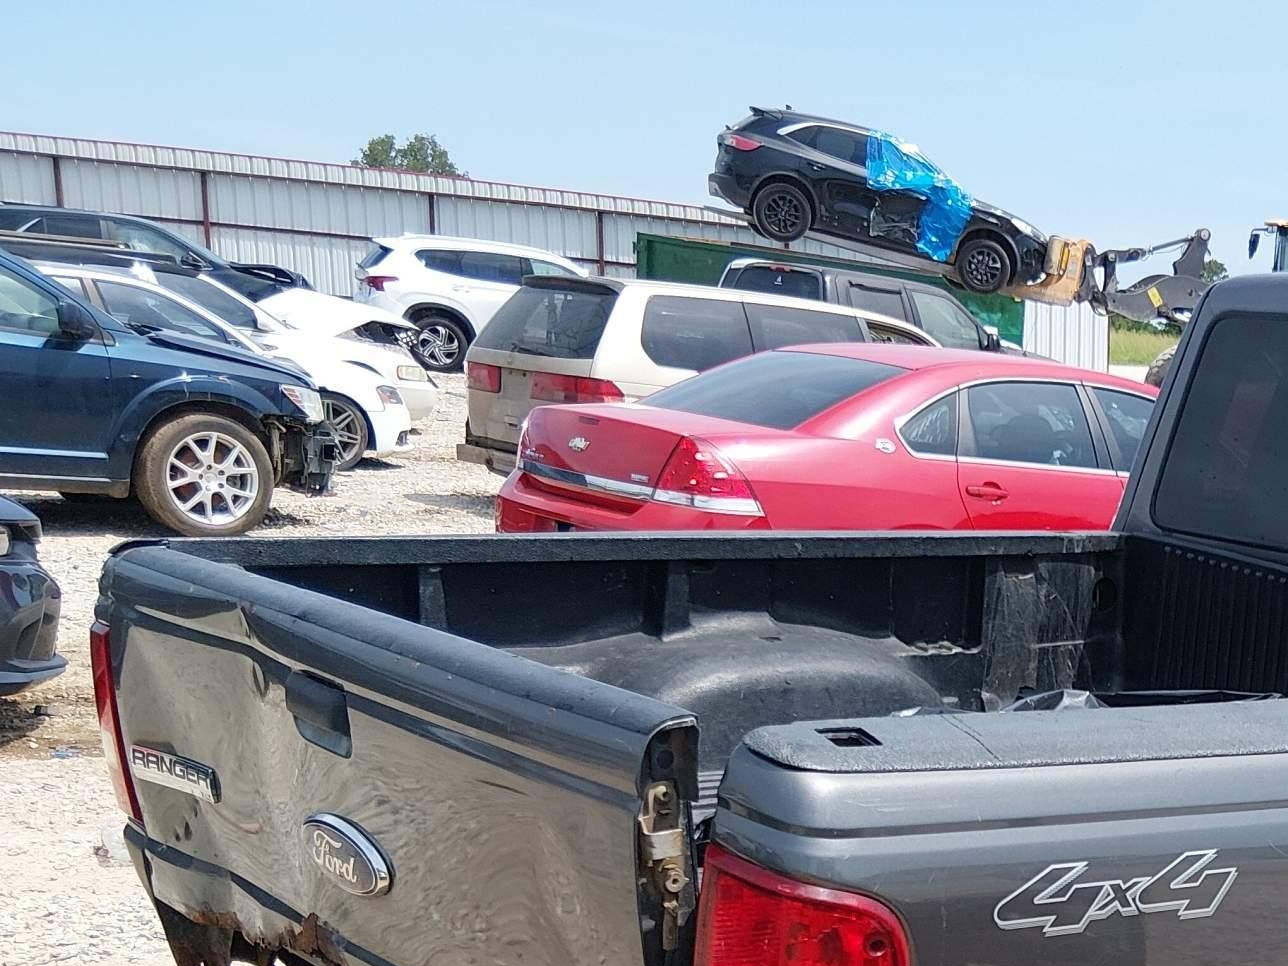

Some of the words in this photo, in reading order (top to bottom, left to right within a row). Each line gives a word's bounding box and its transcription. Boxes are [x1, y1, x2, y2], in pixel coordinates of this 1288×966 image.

[131, 748, 210, 789] RANGER
[312, 829, 358, 884] Ford
[993, 847, 1240, 938] 4x4
